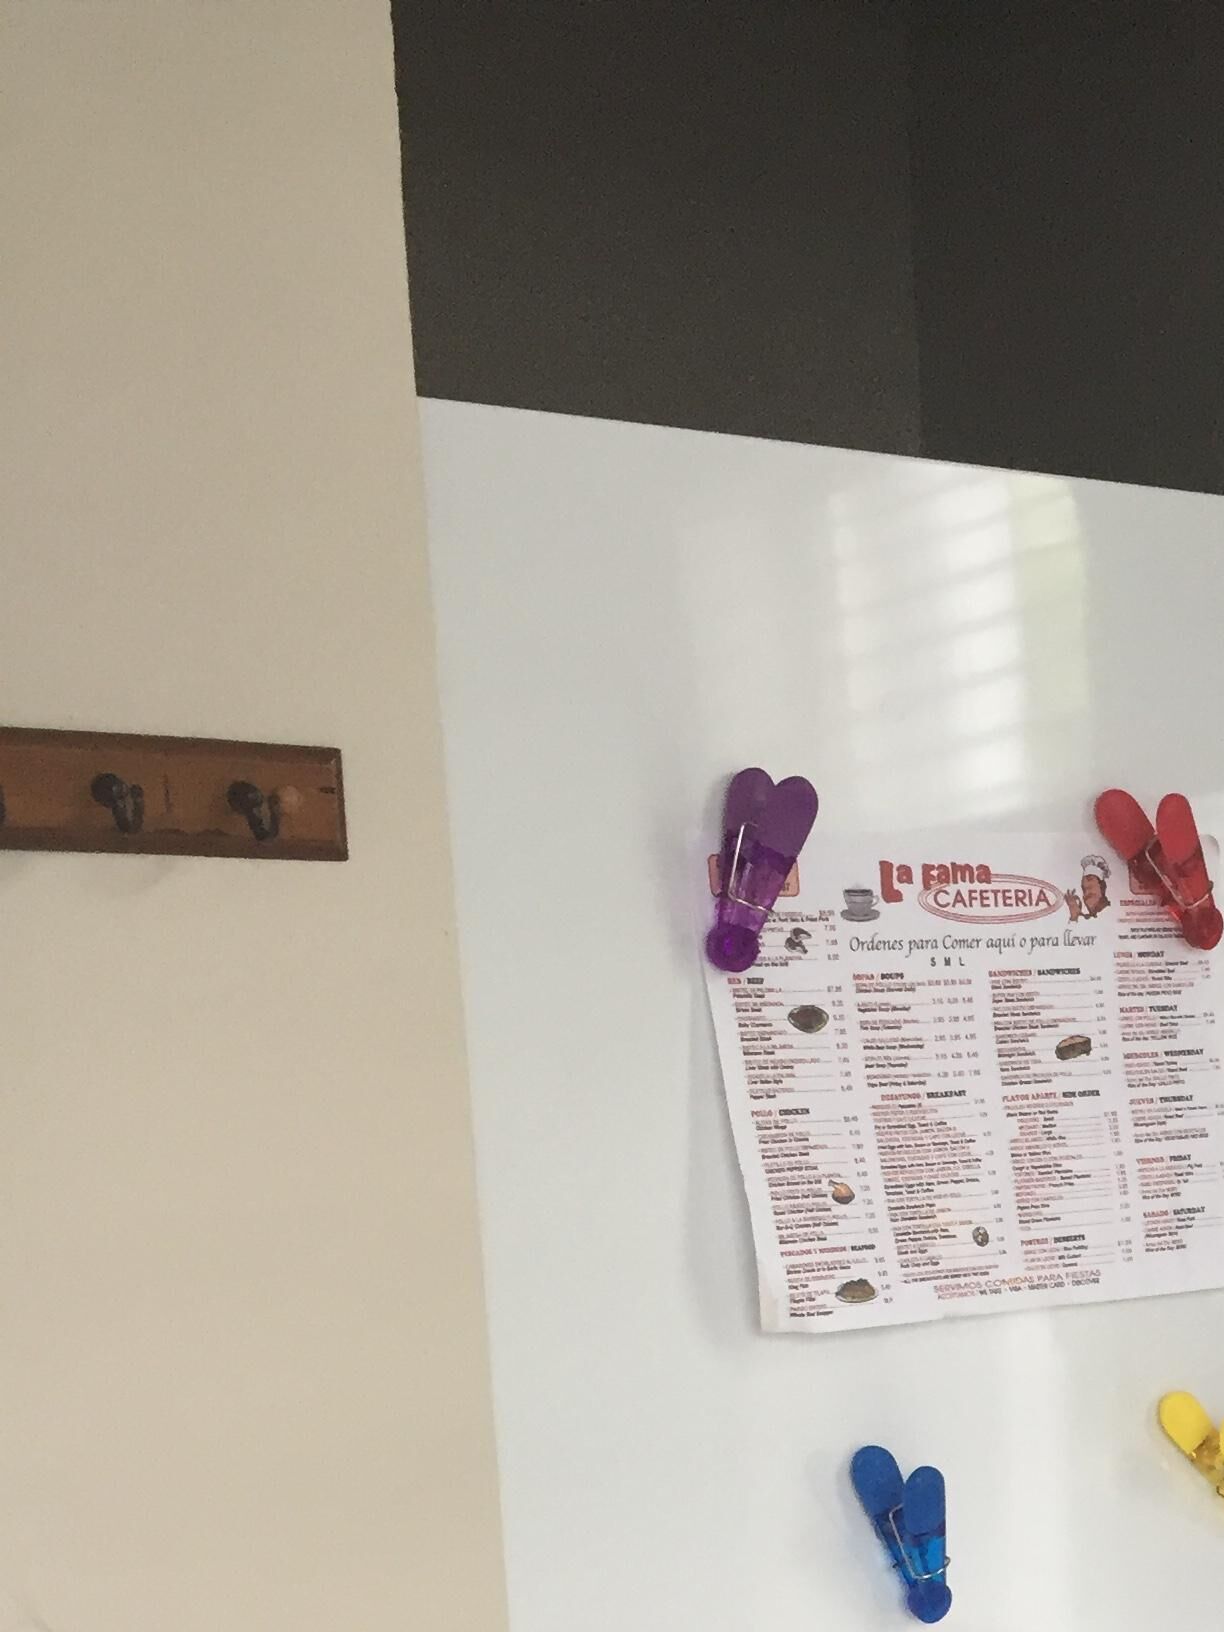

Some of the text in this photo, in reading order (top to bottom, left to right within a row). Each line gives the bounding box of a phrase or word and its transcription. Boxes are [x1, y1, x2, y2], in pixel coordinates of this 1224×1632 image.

[878, 860, 914, 904] La
[933, 887, 1052, 909] CAFETERIA
[849, 932, 905, 953] Ordenes
[906, 936, 939, 958] para
[942, 934, 983, 951] Comer
[1019, 938, 1027, 949] o
[1028, 936, 1060, 955] para
[1063, 928, 1097, 948] llevar
[930, 957, 937, 967] S
[958, 956, 965, 967] L
[1037, 967, 1081, 976] SANDWICHES
[1163, 1048, 1204, 1057] WEDNESDAY
[926, 1089, 967, 1099] BREAKFAST
[1158, 1094, 1194, 1104] THURSDAY
[1173, 1206, 1206, 1216] SATURDAY
[933, 1282, 982, 1294] SERVIMOS
[1036, 1273, 1063, 1283] PARA
[1065, 1268, 1102, 1280] FIESTAS
